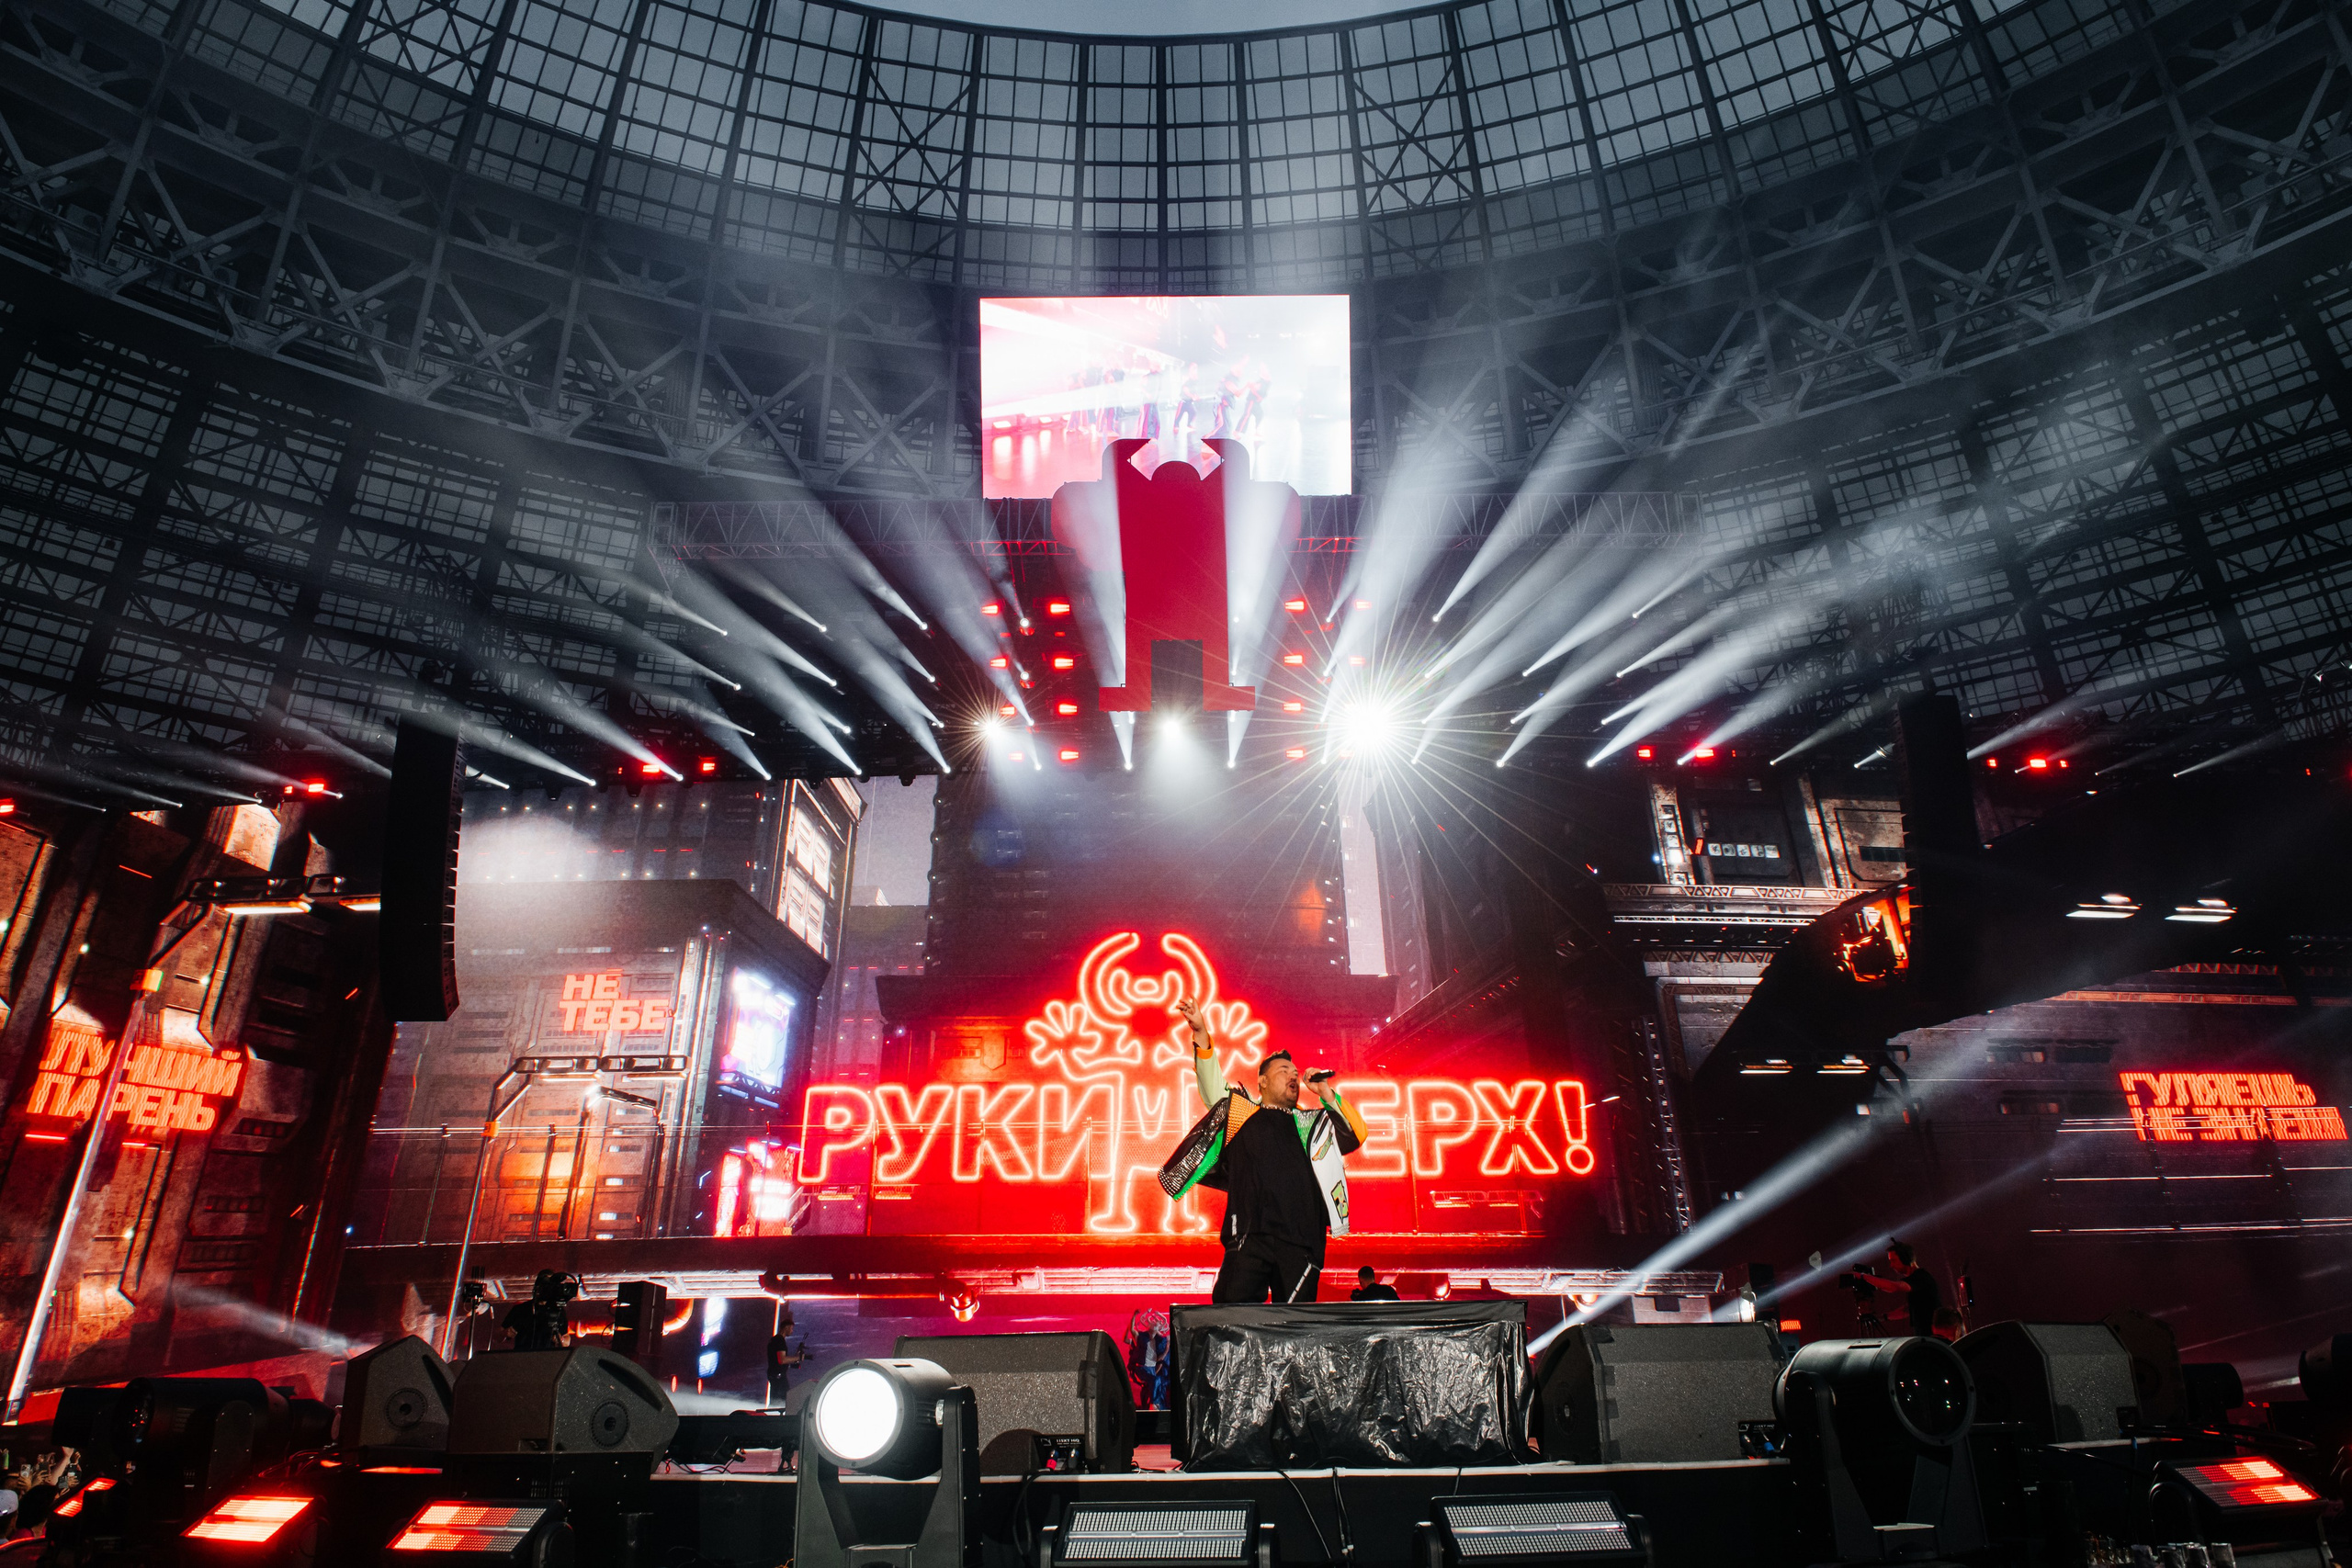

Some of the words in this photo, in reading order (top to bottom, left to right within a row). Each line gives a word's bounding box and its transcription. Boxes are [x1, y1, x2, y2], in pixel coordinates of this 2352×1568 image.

[562, 973, 622, 1000] НЕ
[559, 998, 670, 1032] ТЕБЕ
[26, 1072, 216, 1131] ПАРЕНЬ
[2119, 1072, 2317, 1107] ГУЛЯЕШЬ
[797, 1085, 1115, 1183] РУКИ
